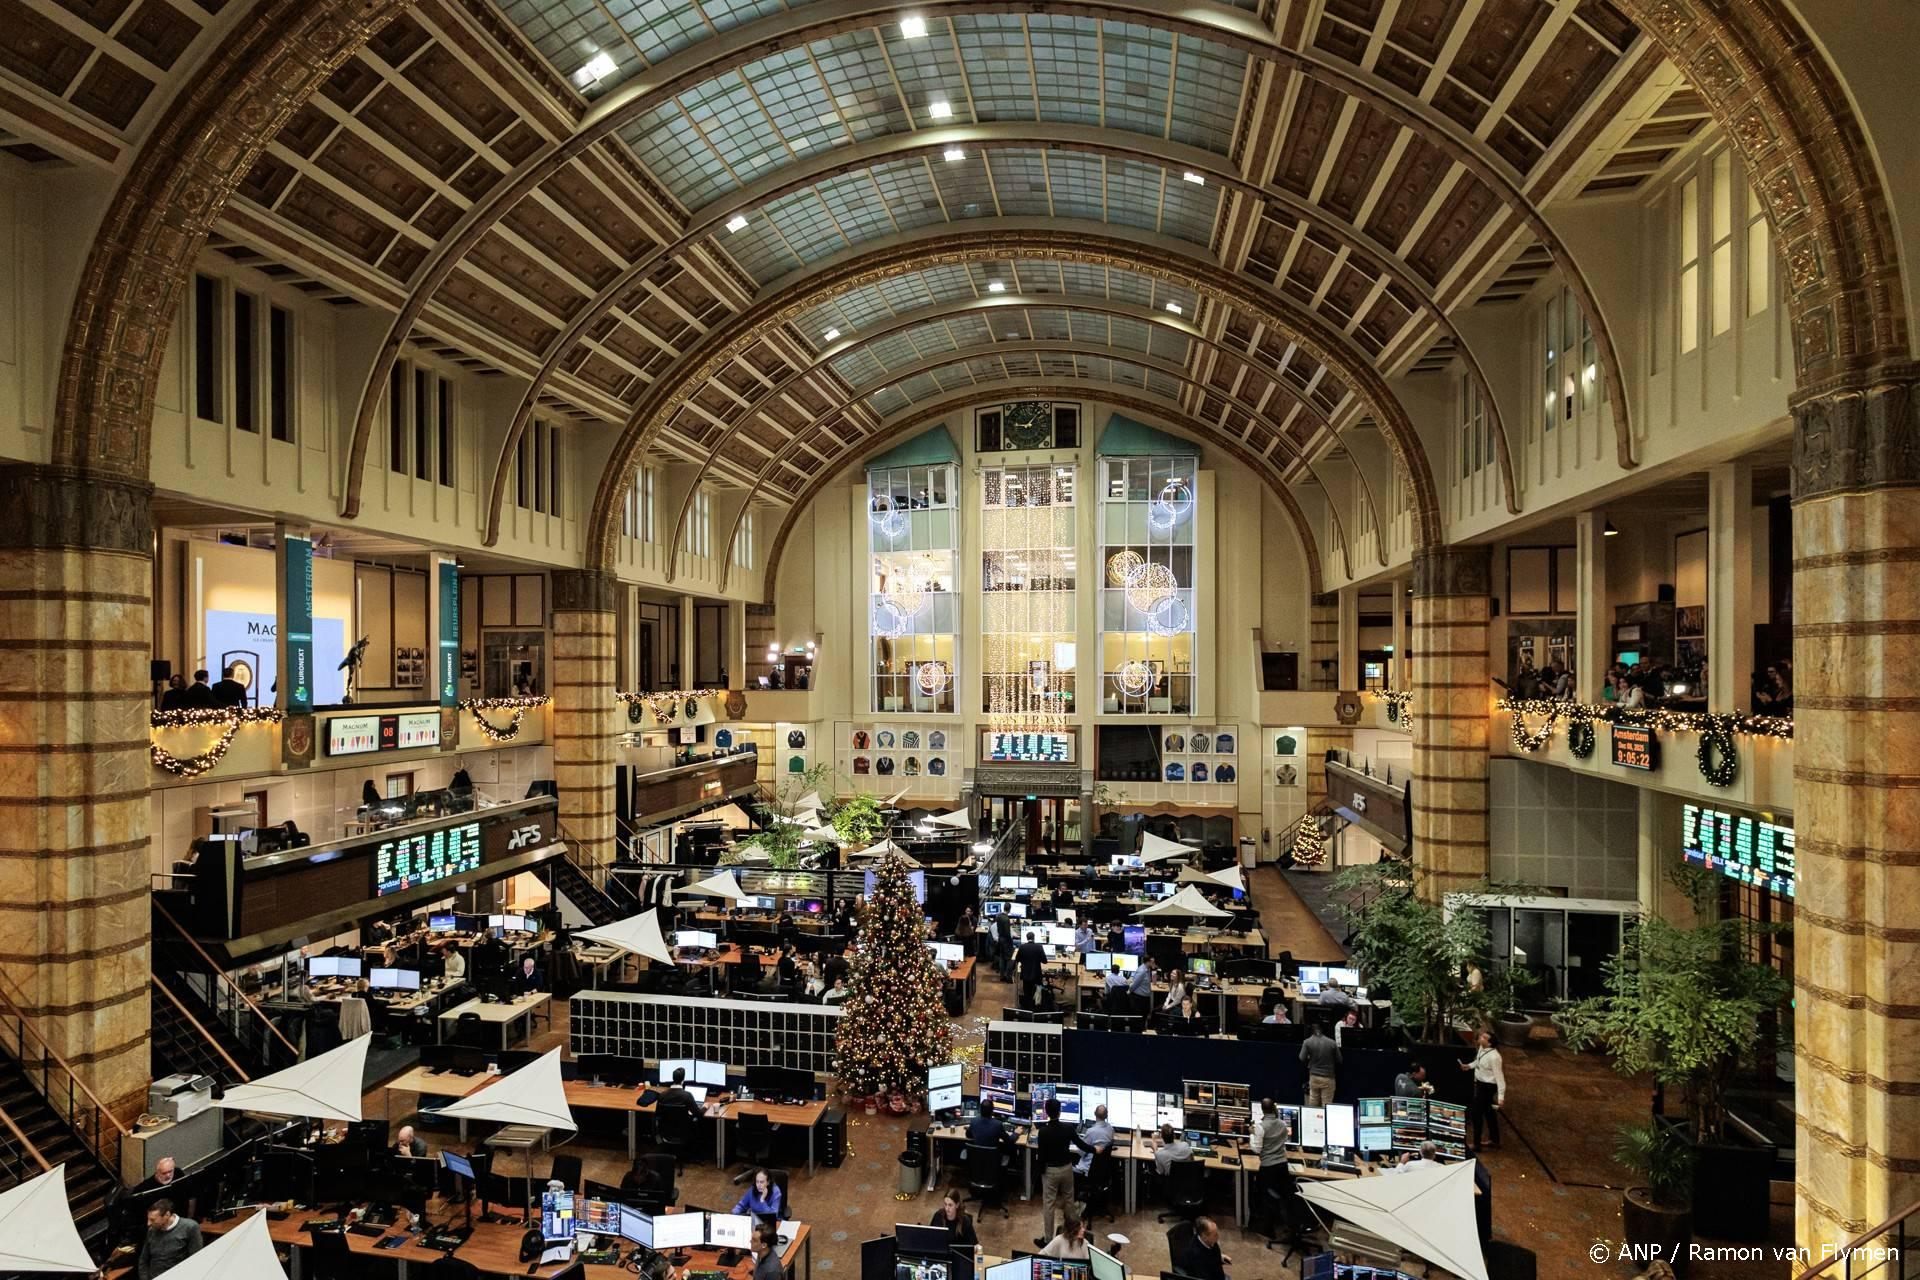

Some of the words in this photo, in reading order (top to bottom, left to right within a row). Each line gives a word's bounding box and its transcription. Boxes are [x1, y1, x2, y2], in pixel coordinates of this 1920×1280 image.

[305, 548, 313, 619] AMSTERDAM
[1613, 729, 1649, 742] Amsterdam
[1617, 750, 1650, 767] 9:05:22
[507, 824, 541, 850] AFS
[380, 878, 401, 890] randstad
[408, 872, 421, 881] RELX
